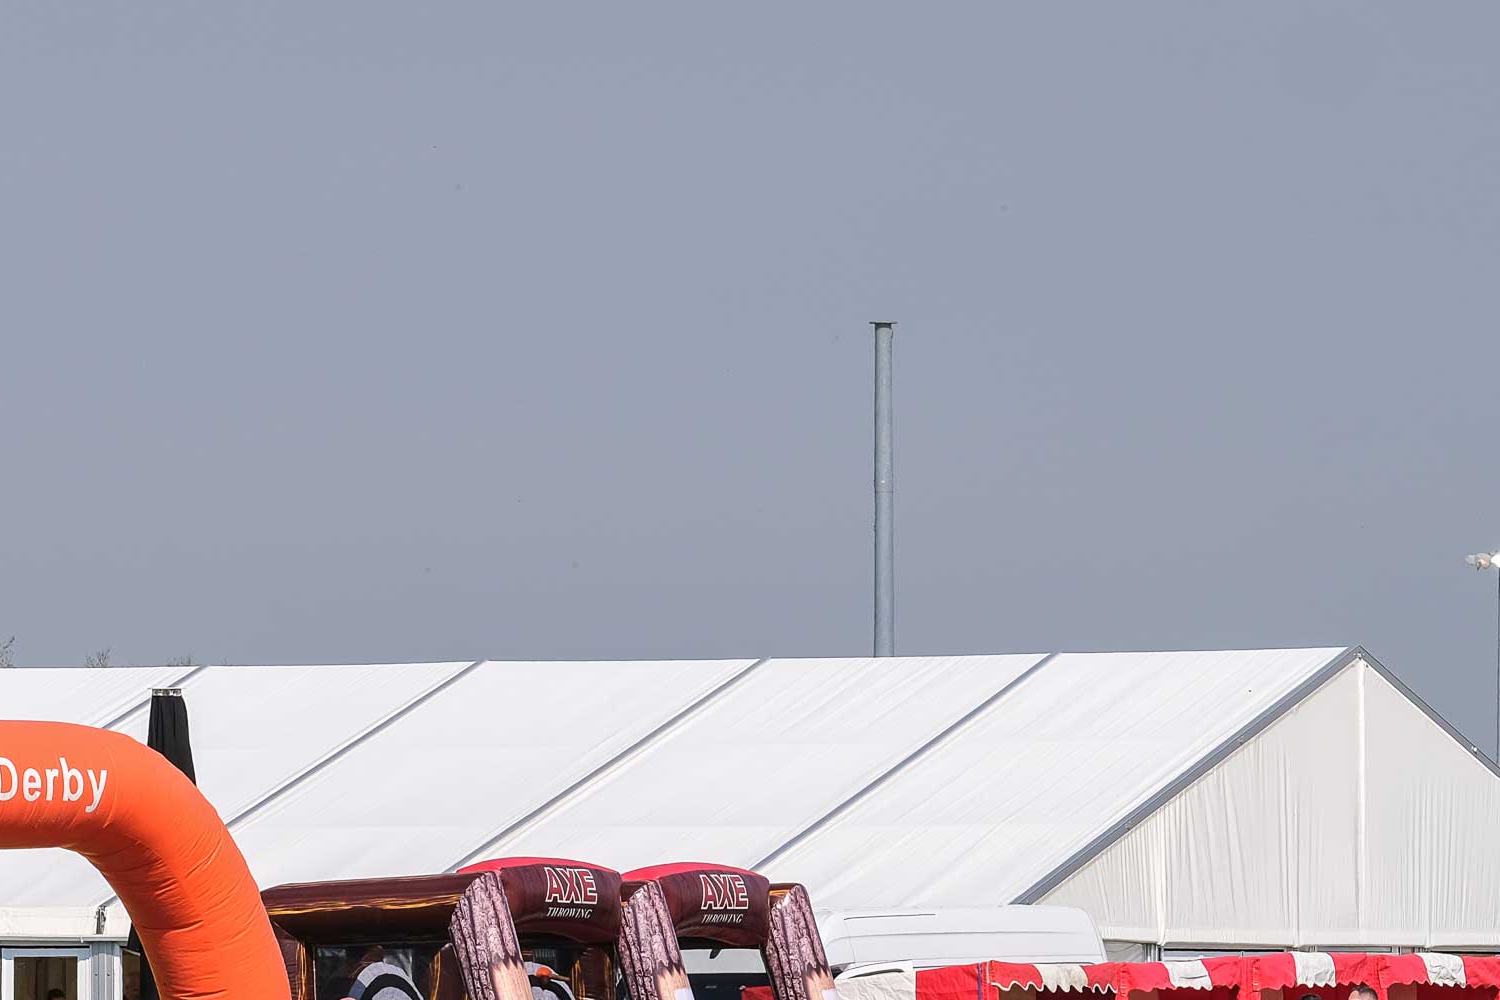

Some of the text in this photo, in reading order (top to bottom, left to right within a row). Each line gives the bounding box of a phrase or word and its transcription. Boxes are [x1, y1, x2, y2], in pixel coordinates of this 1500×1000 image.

[544, 867, 597, 904] AXE
[700, 875, 749, 910] AXE
[546, 907, 592, 919] THROWING
[701, 913, 744, 924] THROWING
